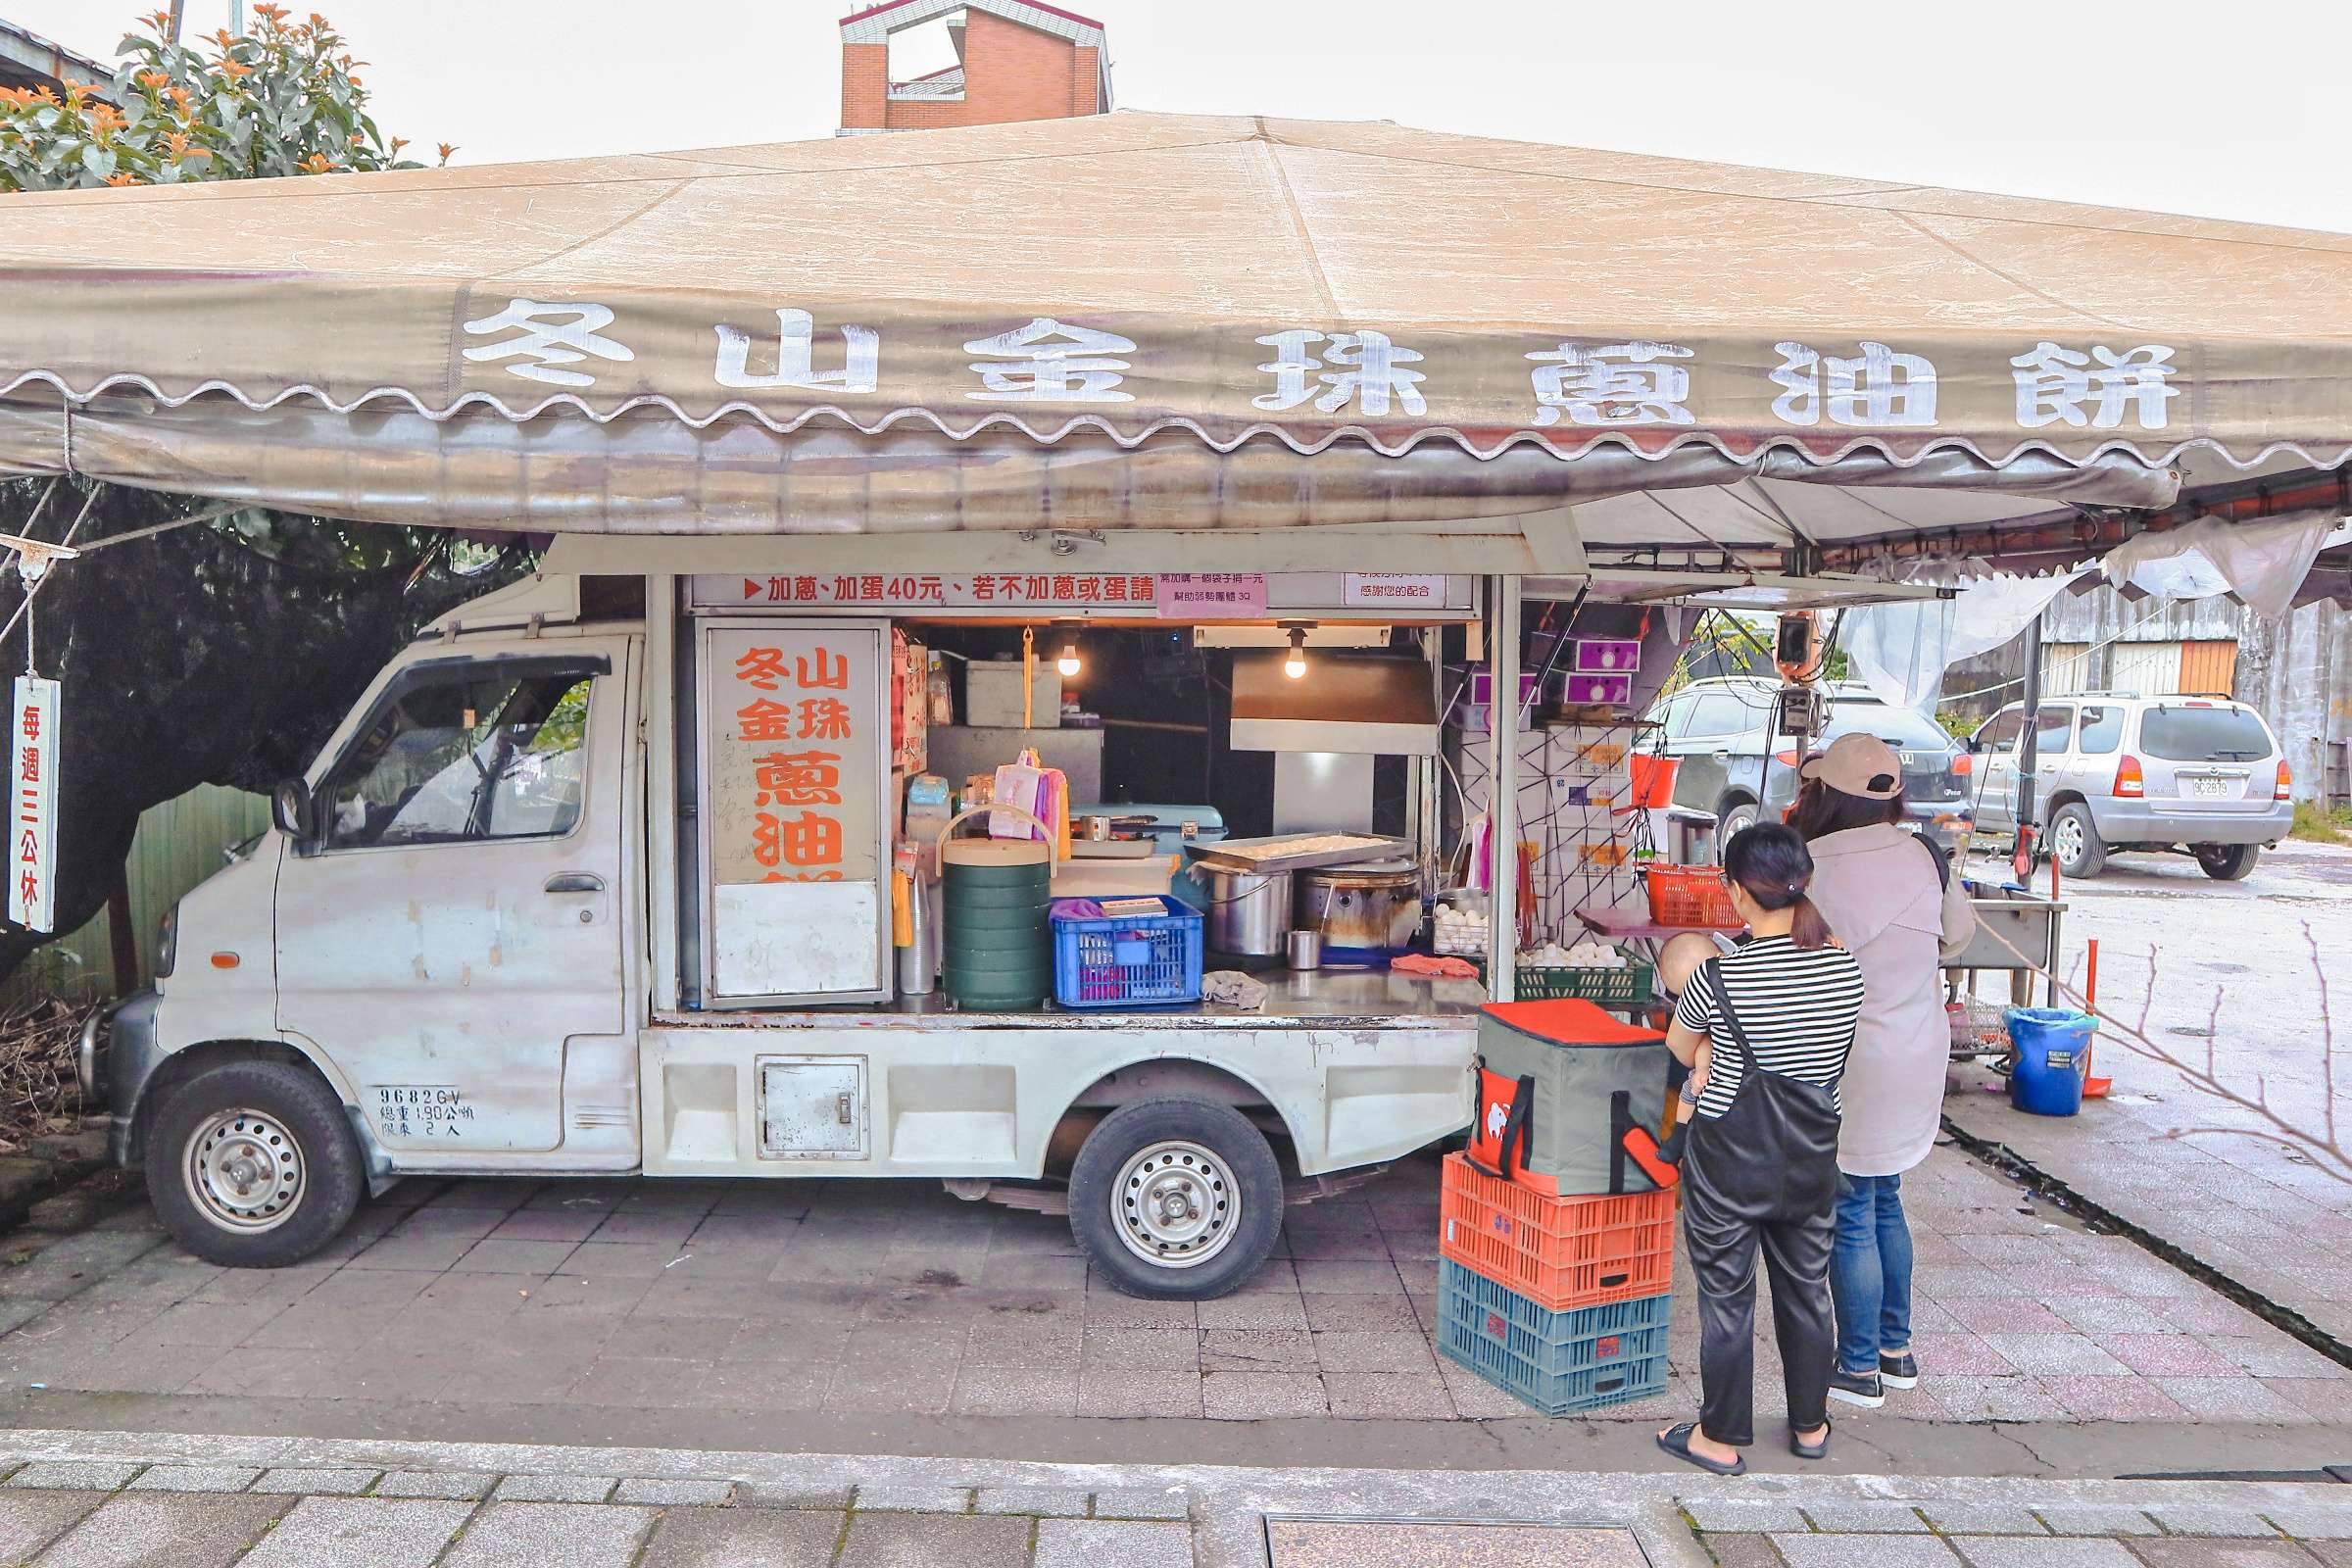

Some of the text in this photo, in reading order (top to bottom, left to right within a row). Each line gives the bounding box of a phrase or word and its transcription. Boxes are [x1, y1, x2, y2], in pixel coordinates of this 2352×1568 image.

[1360, 585, 1430, 597] 感謝您的配合
[20, 705, 40, 906] 每週三公休
